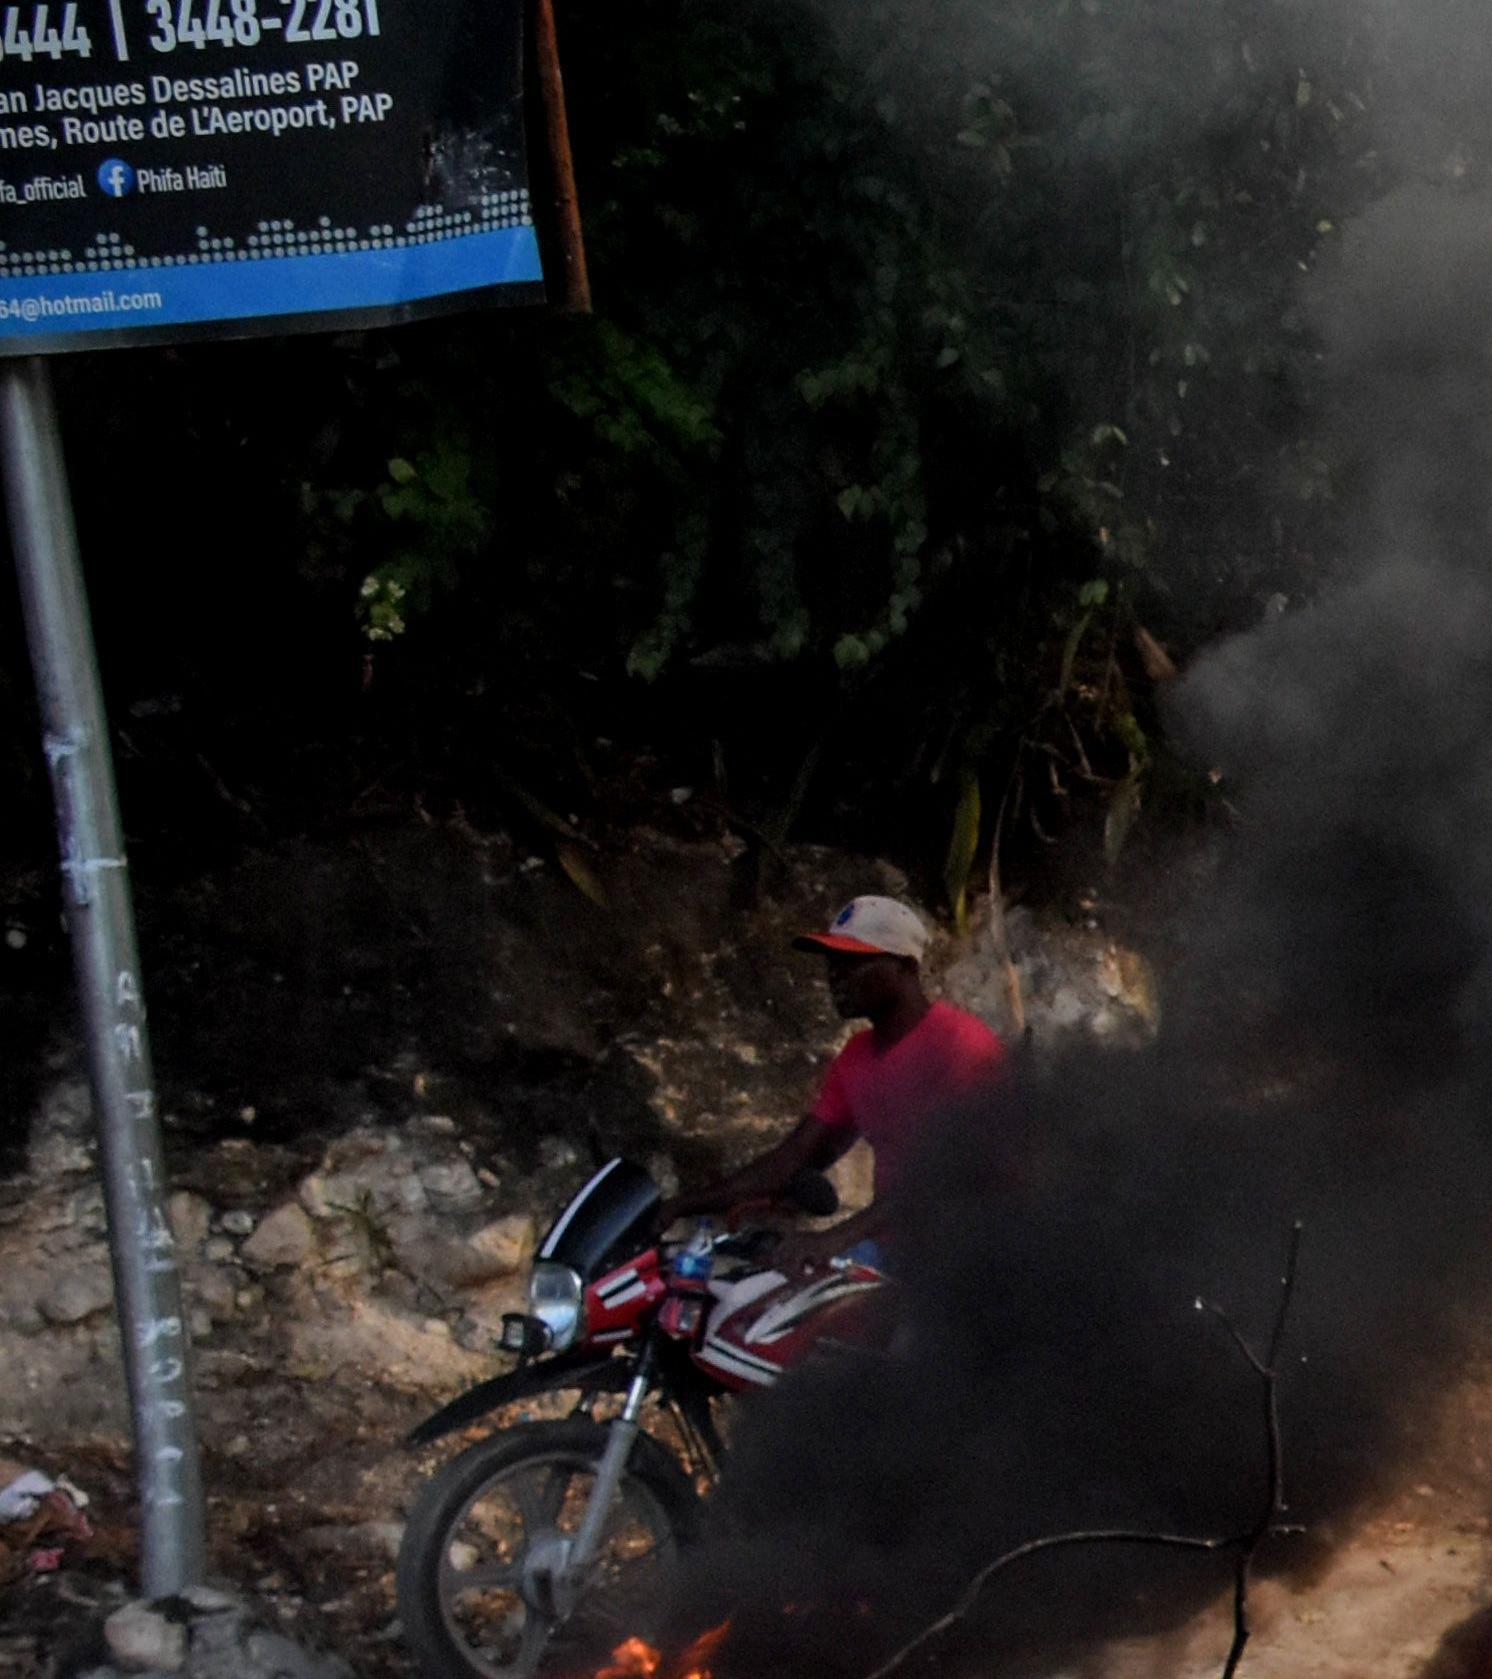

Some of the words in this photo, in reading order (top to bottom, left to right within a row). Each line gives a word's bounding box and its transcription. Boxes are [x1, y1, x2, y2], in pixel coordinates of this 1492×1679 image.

[0, 2, 92, 61] 444
[147, 0, 380, 52] 3448-2281
[35, 82, 146, 115] Jacques
[152, 68, 300, 103] Dessalines
[306, 61, 359, 91] PAP
[63, 114, 145, 145] Route
[151, 109, 186, 138] de
[189, 99, 336, 136] L'Aeroport,
[340, 93, 394, 124] PAP
[137, 168, 184, 193] Phifa
[186, 164, 228, 190] Haiti
